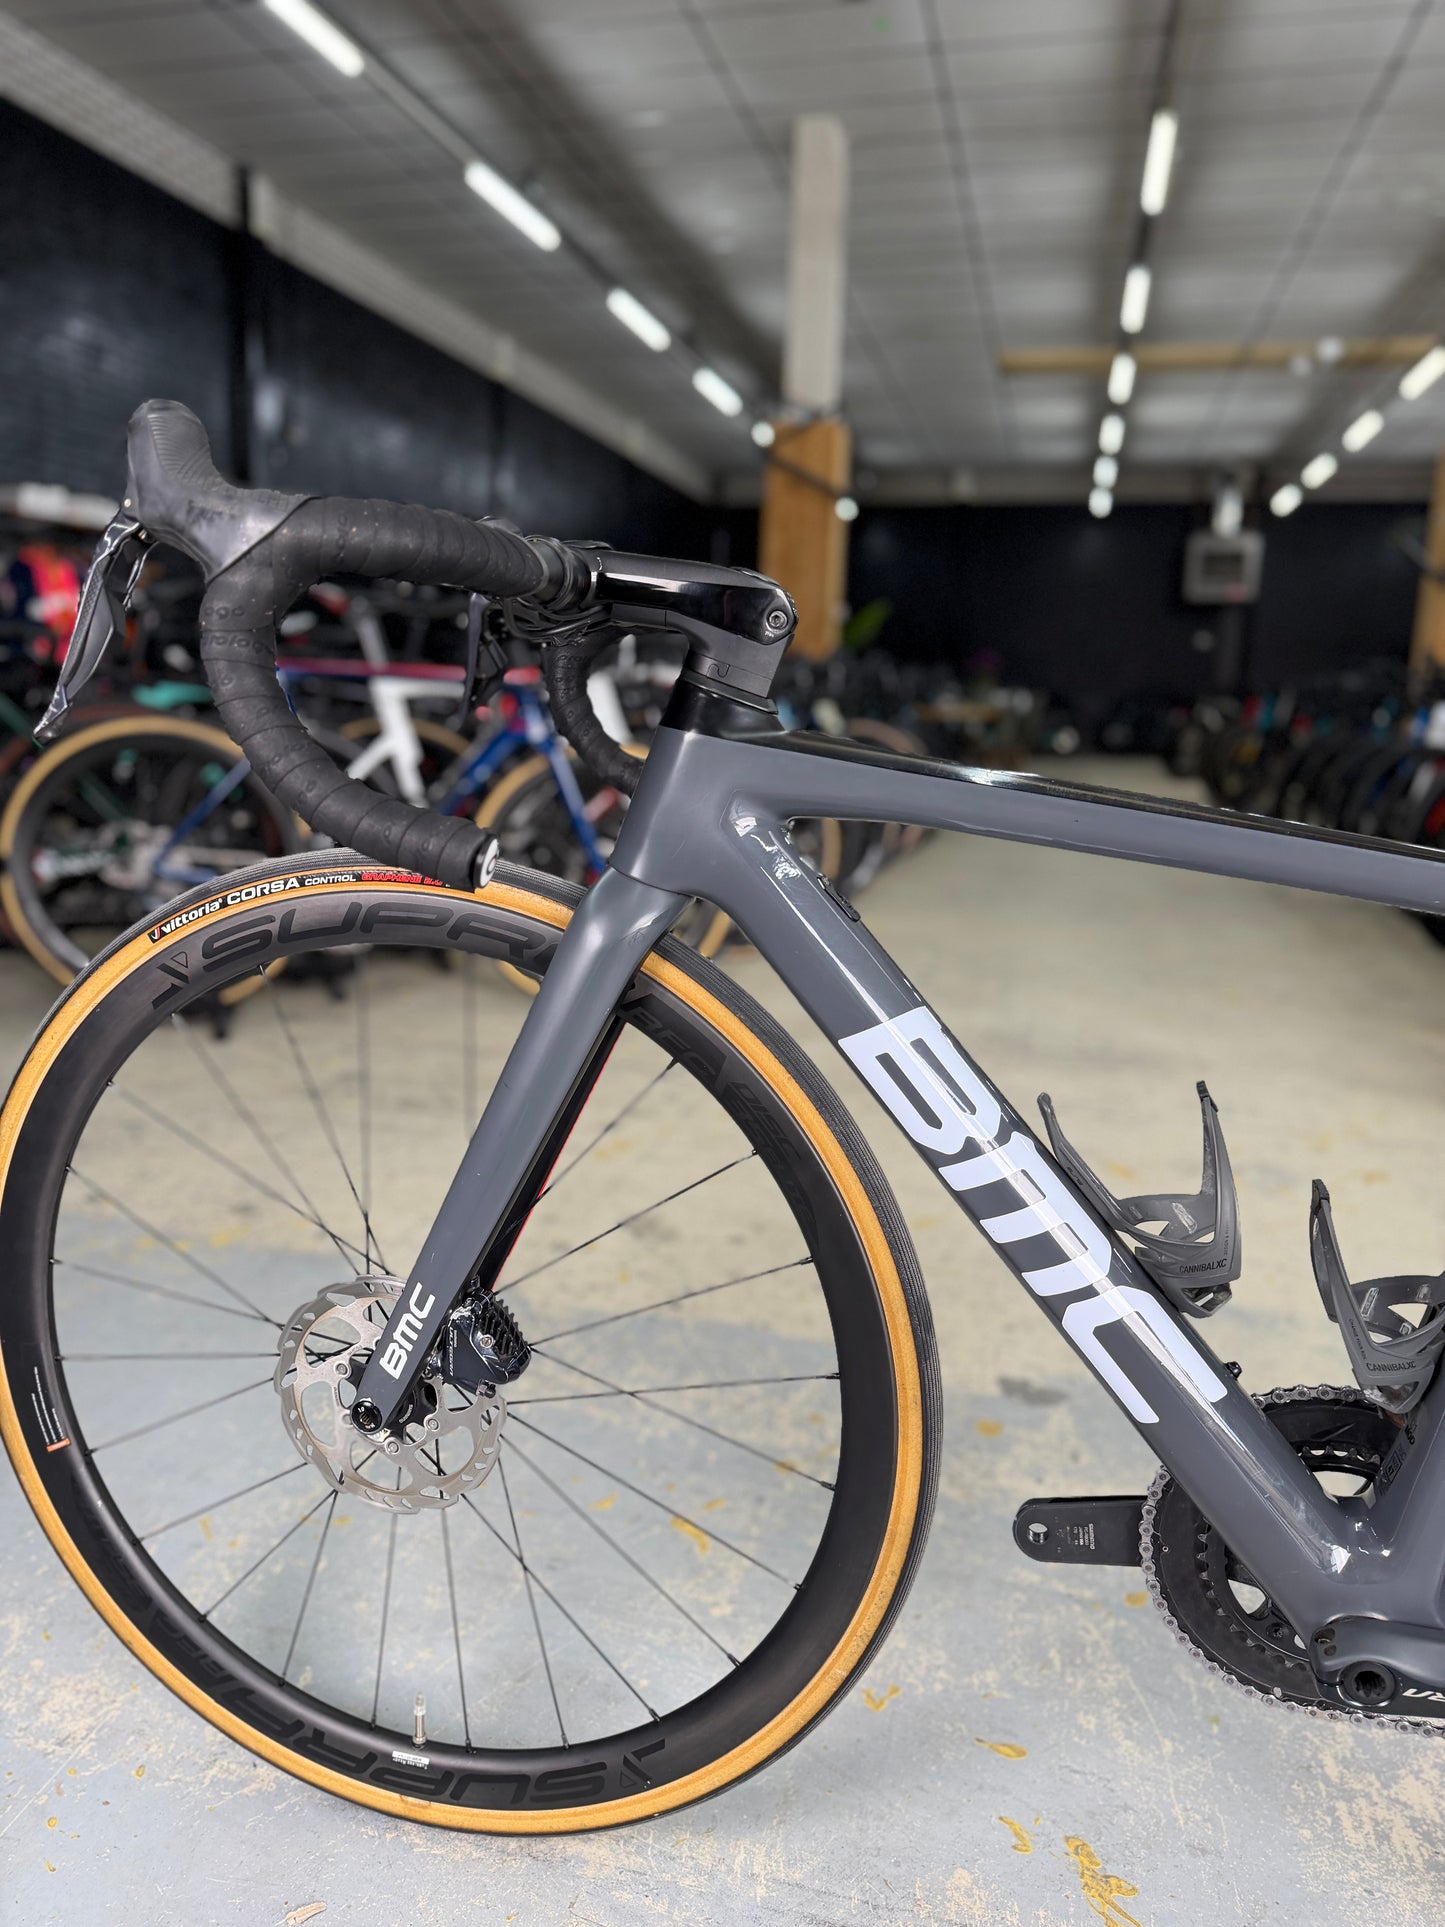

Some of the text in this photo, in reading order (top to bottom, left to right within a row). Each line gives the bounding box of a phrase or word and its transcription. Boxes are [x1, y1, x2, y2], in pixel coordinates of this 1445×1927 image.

[227, 877, 300, 905] CORSA
[304, 874, 356, 886] CONTROL
[837, 1006, 1228, 1424] BMC
[379, 1282, 436, 1380] BMC
